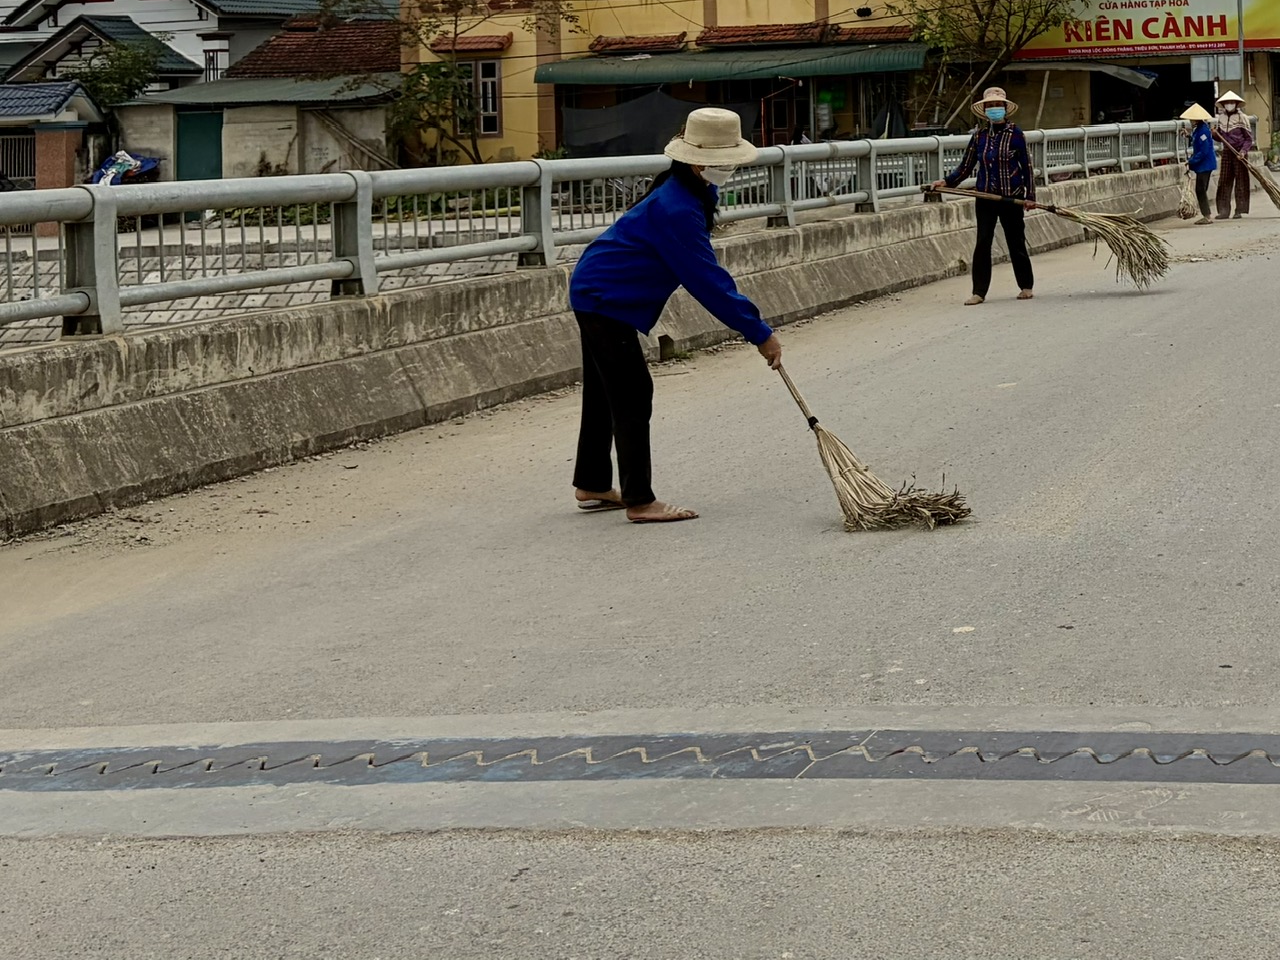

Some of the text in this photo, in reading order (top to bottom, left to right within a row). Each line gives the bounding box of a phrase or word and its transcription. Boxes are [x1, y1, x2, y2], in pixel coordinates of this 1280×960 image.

[1098, 0, 1118, 10] CỬA
[1120, 0, 1147, 10] HÀNG
[1149, 0, 1166, 10] TẠP
[1141, 12, 1228, 39] CÀNH
